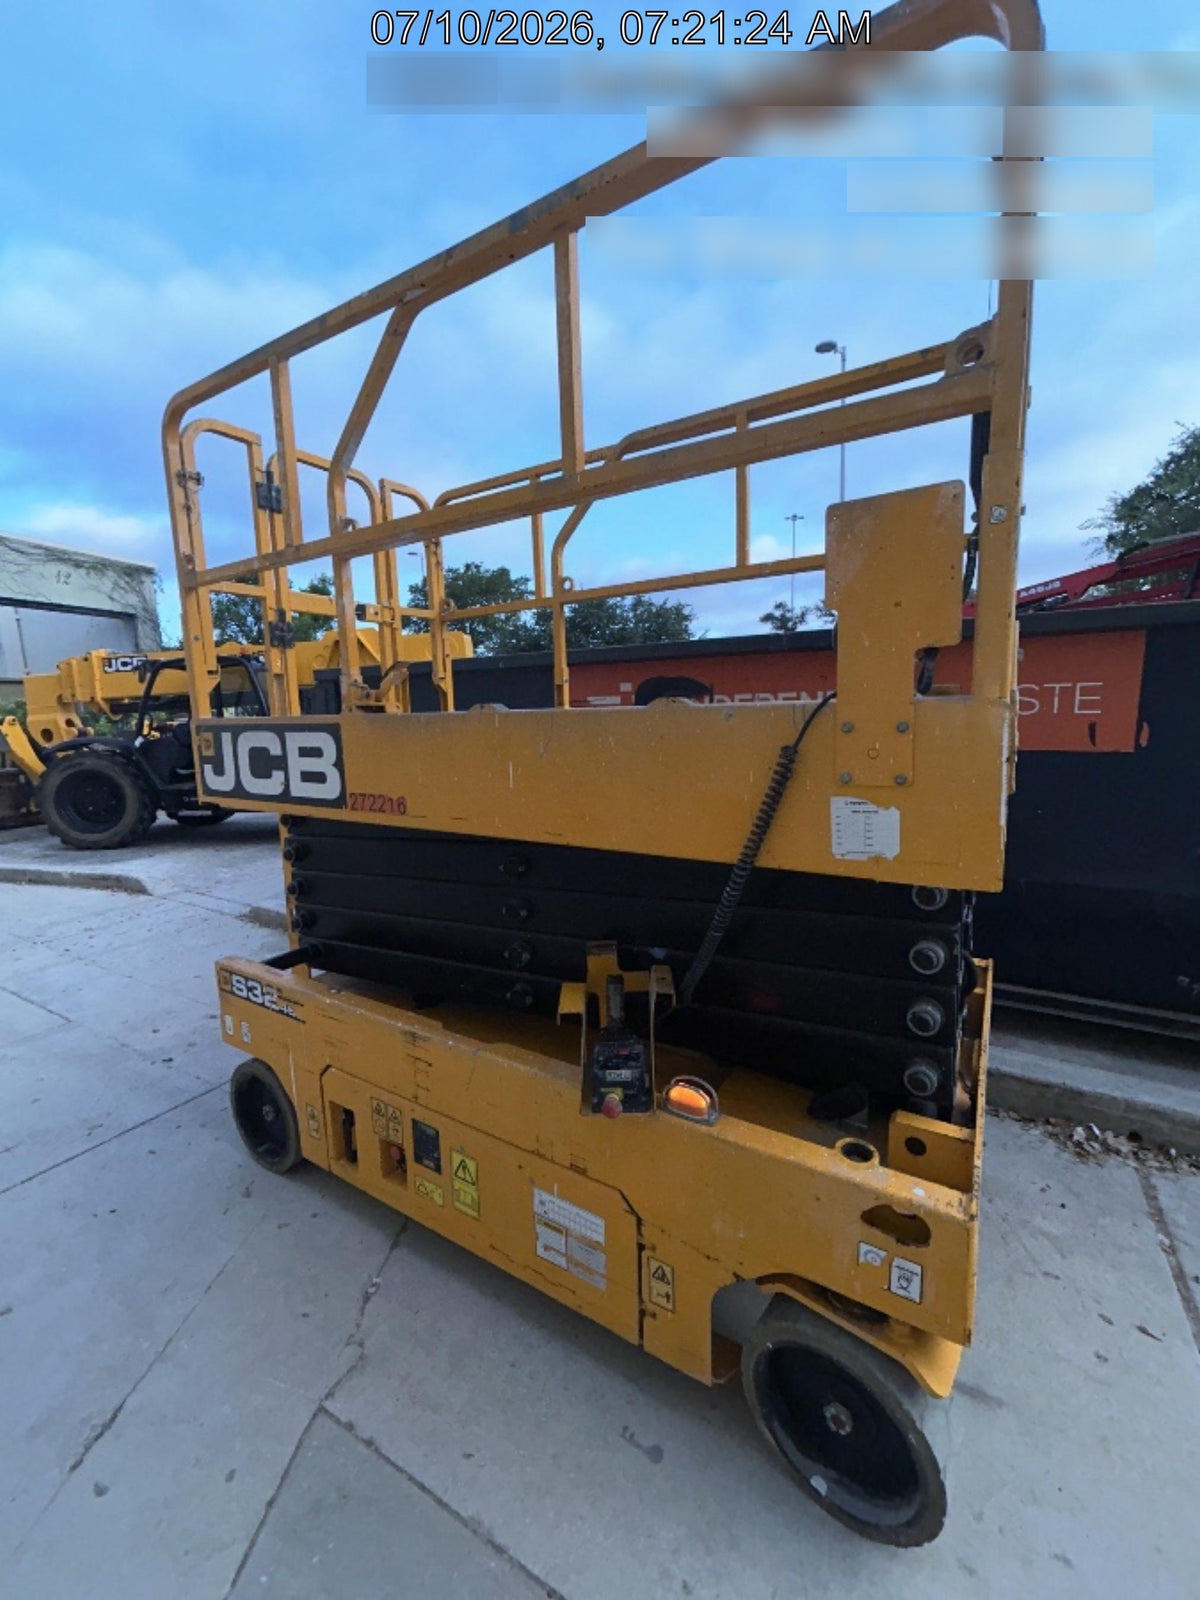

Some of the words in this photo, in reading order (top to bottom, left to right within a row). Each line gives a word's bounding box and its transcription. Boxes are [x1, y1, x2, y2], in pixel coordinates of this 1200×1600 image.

[1017, 681, 1104, 715] STE
[203, 730, 342, 800] JCB
[349, 792, 408, 816] 272216
